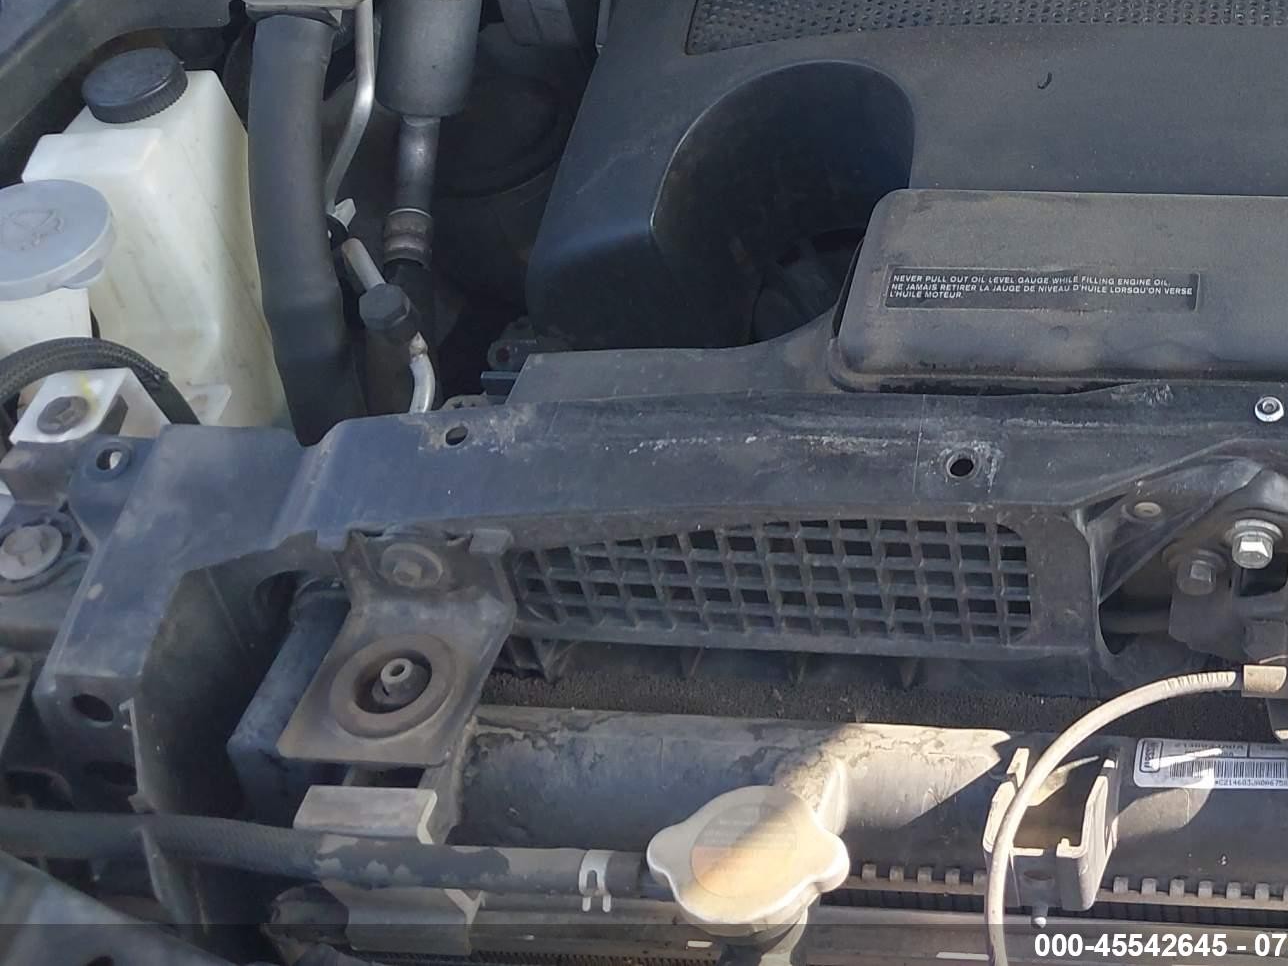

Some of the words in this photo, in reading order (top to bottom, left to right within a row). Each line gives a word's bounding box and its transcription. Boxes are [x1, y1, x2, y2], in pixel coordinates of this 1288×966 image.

[893, 275, 923, 283] NEVER
[925, 275, 947, 283] PULL
[950, 275, 969, 283] OUT
[971, 275, 986, 284] OIL
[988, 276, 1015, 284] LEVEL
[1017, 276, 1049, 285] GAUGE
[1051, 275, 1079, 285] WHILE
[1081, 276, 1115, 286] FILLING
[1117, 277, 1151, 286] ENGINE
[889, 291, 922, 299] L'HUILE
[891, 283, 903, 291] NE
[905, 284, 938, 292] JAMAIS
[939, 284, 977, 292] RETIRER
[979, 284, 990, 292] LA
[992, 285, 1021, 293] JAUGE
[1023, 285, 1036, 293] DE
[1038, 285, 1070, 293] NIVEAU
[1072, 284, 1108, 294] D'HUILE
[1110, 286, 1162, 295] LORSQU'ON
[1164, 287, 1193, 296] VERSE
